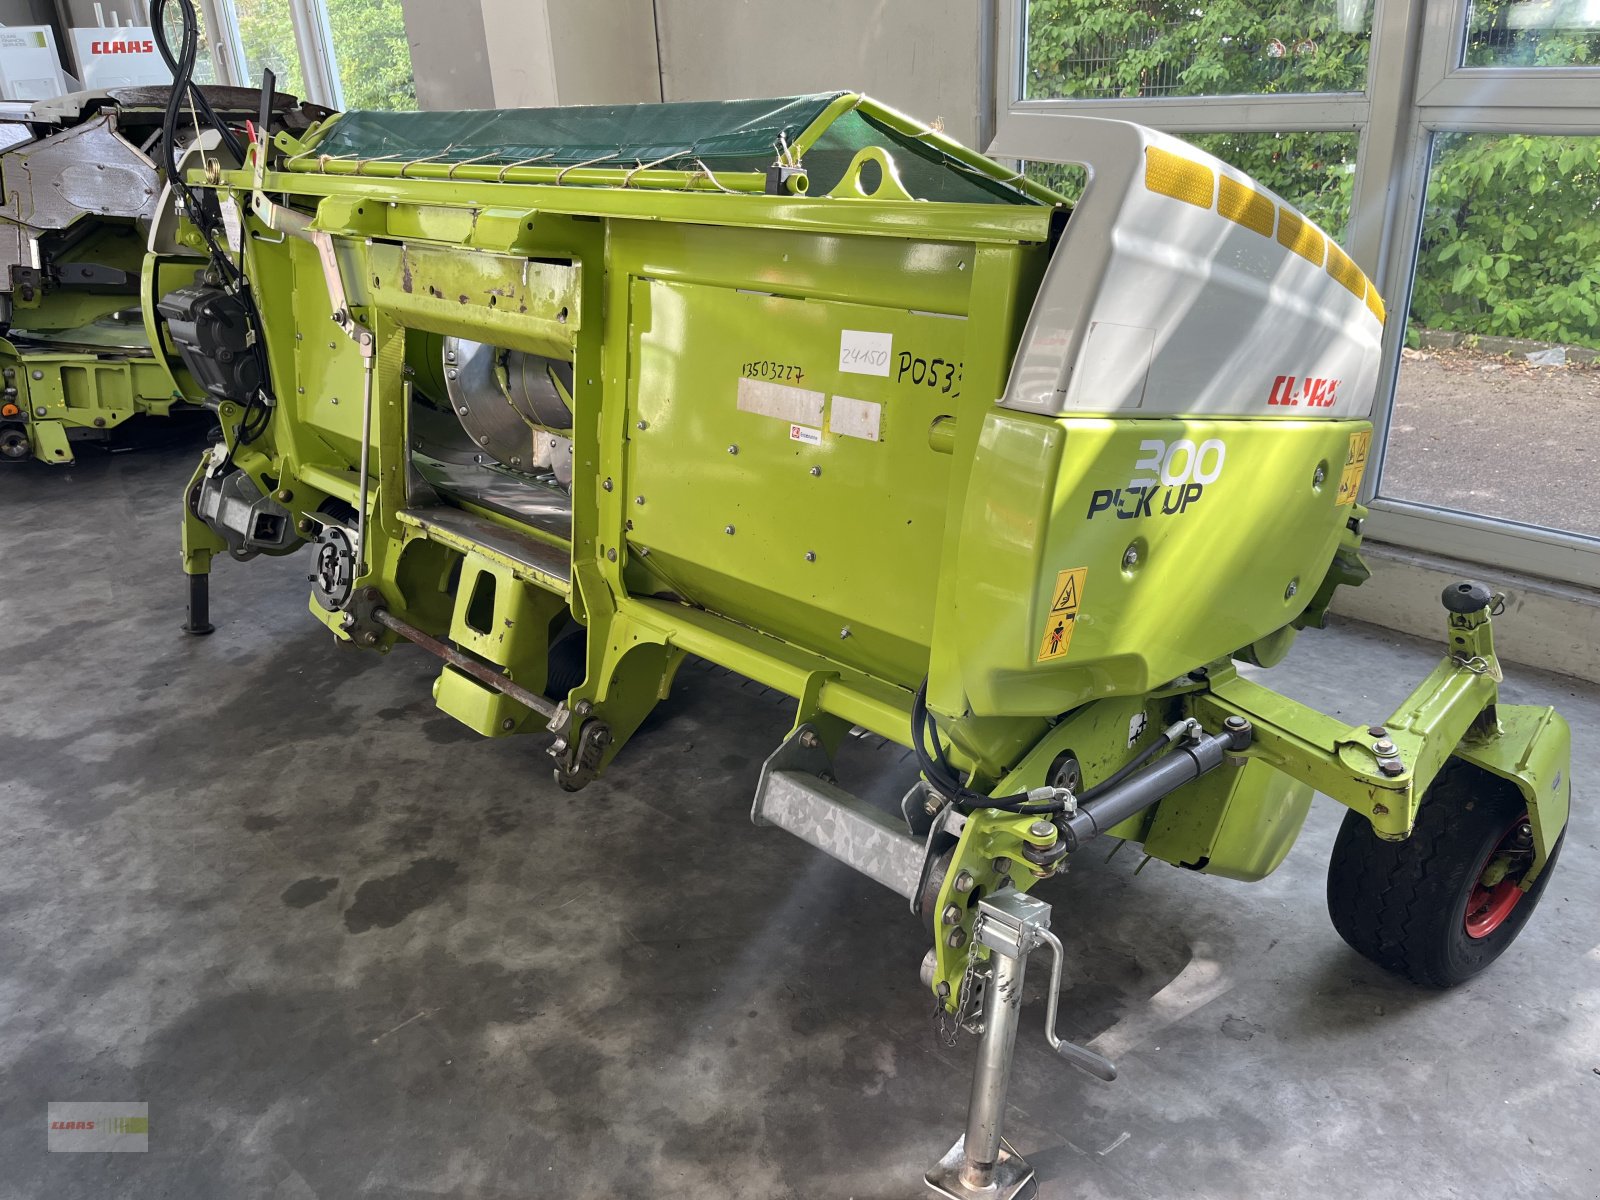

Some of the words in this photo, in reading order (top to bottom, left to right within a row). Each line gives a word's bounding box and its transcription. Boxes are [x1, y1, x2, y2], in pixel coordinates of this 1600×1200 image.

[92, 41, 153, 54] CLAAS
[842, 348, 888, 366] 24150
[742, 361, 805, 384] 13503227
[1128, 438, 1226, 488] 300
[1160, 483, 1203, 515] UP
